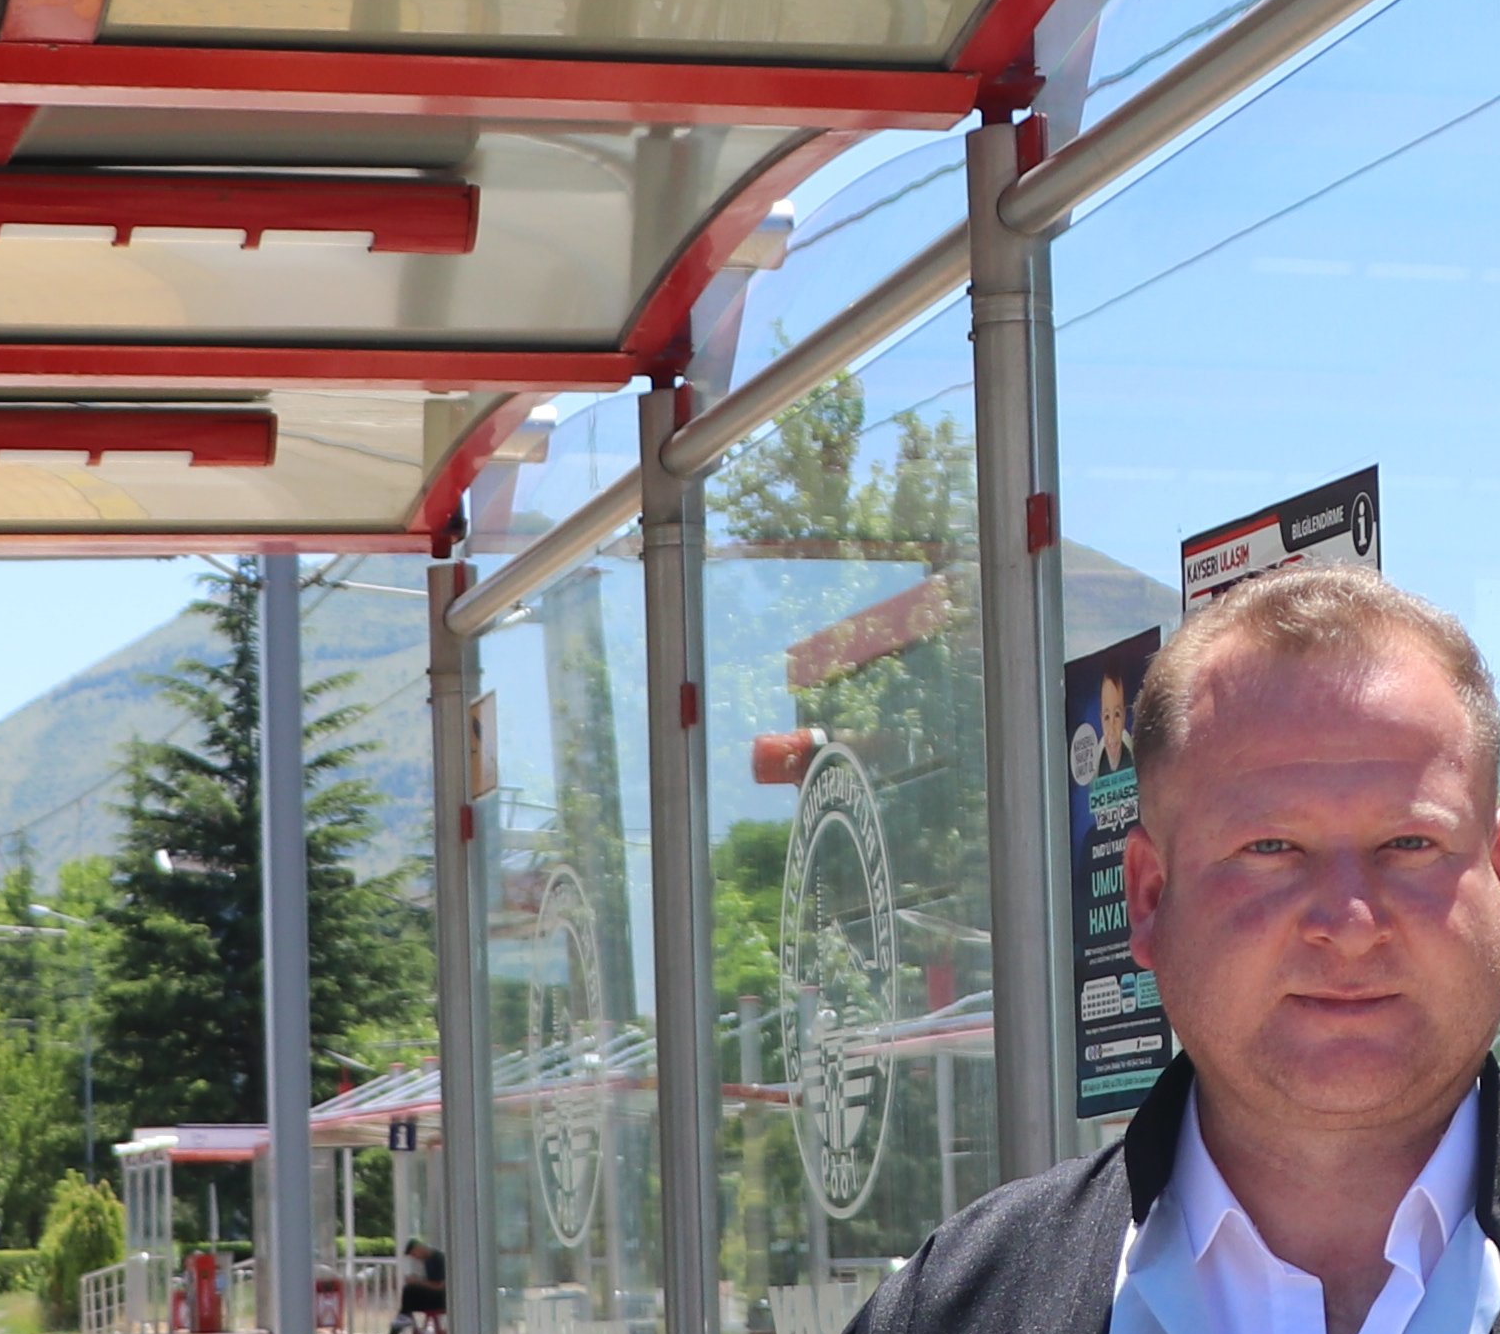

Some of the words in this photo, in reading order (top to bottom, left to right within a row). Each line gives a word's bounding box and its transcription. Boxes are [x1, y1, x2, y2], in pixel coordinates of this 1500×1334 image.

[1291, 504, 1344, 541] BİLGİLENDİRME
[1186, 549, 1219, 585] KAYSERİ
[1219, 542, 1250, 573] ULAŞIM
[1092, 865, 1124, 898] UMUT
[1089, 900, 1127, 935] HAYAT
